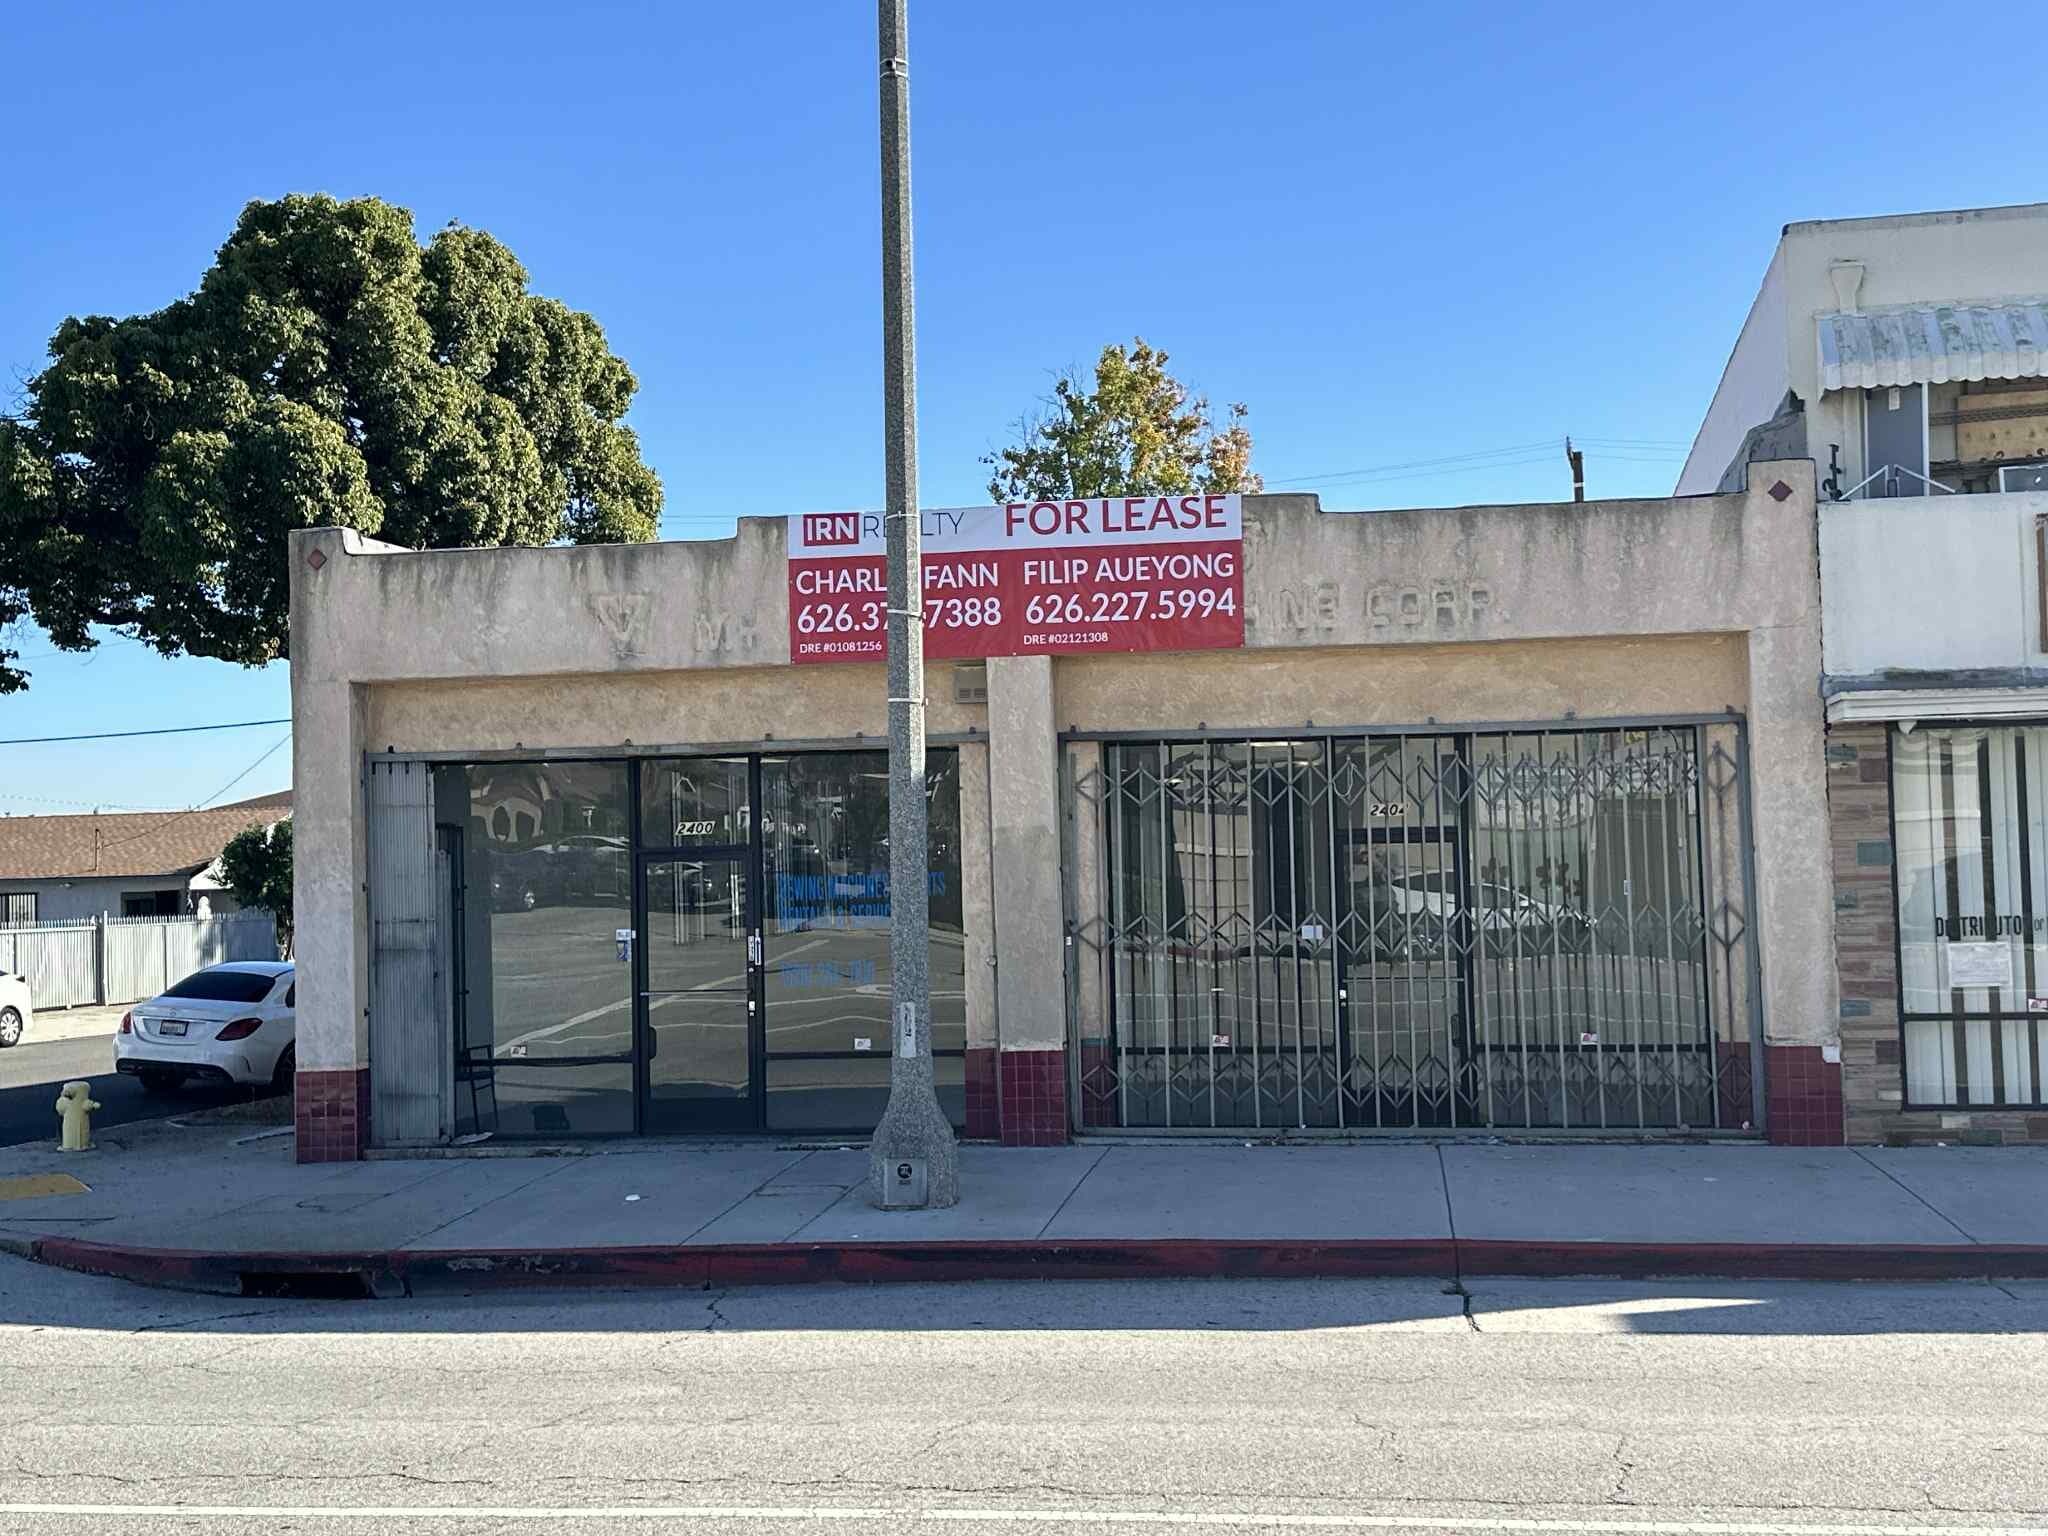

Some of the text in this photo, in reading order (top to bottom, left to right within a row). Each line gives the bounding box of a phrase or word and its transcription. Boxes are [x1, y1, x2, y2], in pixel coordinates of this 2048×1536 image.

[807, 511, 965, 541] IRN RLTY
[1006, 495, 1227, 536] FOR LEASE
[924, 563, 999, 589] FANN
[1023, 552, 1235, 585] FILIP AUEYONG
[1025, 587, 1237, 625] 626.227.5994
[800, 641, 882, 653] DRE #01081256
[1023, 632, 1109, 645] DRE #02121308
[678, 822, 713, 834] 2400
